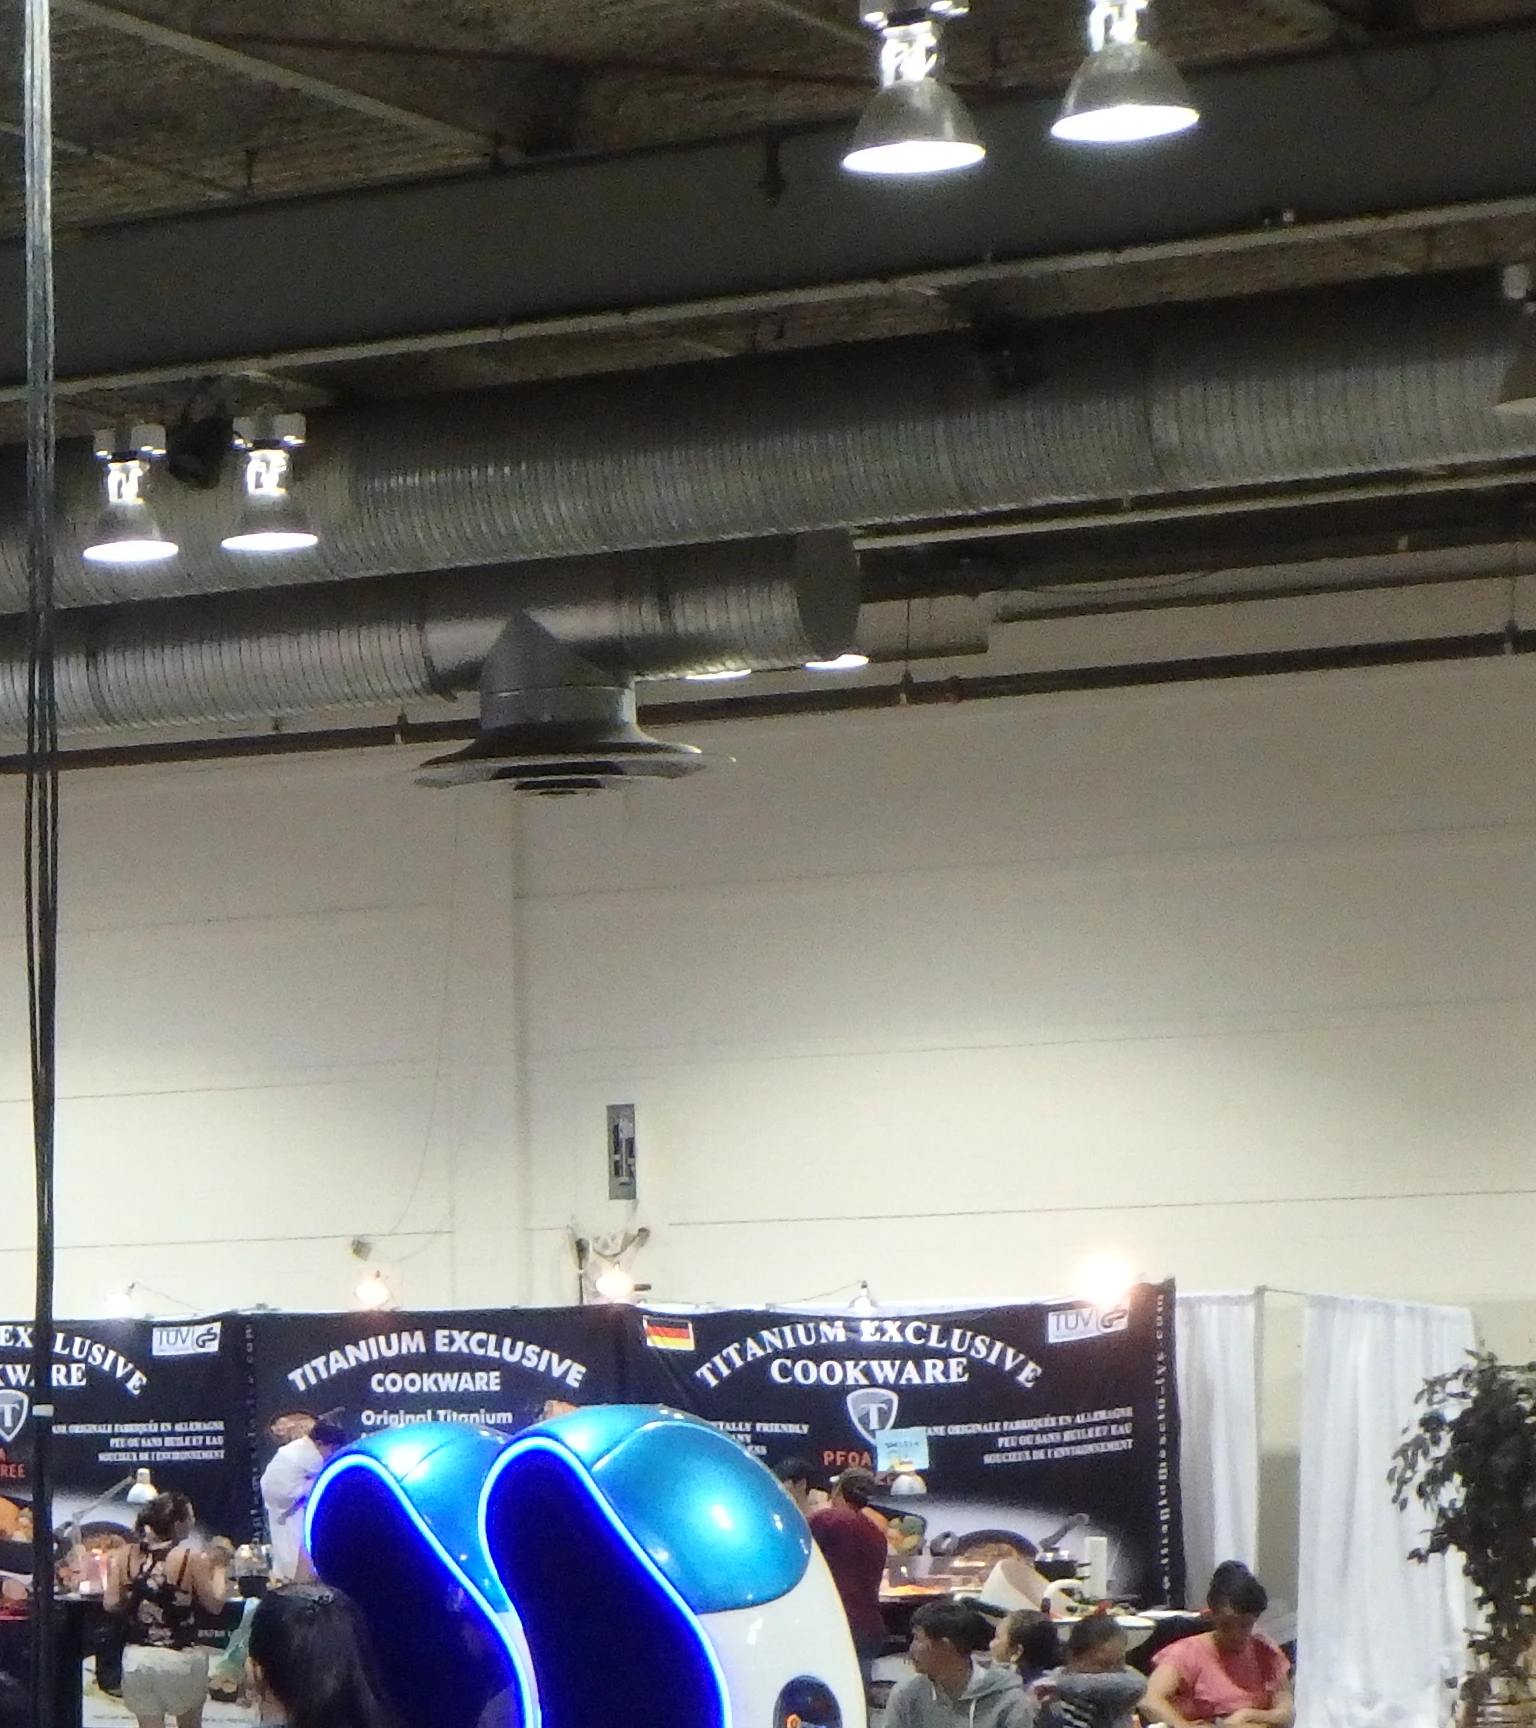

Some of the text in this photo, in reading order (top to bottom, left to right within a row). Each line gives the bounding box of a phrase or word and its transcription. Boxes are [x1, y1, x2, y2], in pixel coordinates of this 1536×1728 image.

[288, 1329, 587, 1392] TITANIUM EXCLUSIVE
[695, 1320, 1043, 1388] TITANIUM EXCLUSIVE
[371, 1372, 501, 1393] COOKWARE
[771, 1357, 969, 1386] COOKWARE
[361, 1408, 513, 1426] Original Titanium
[823, 1450, 874, 1466] PFOA
